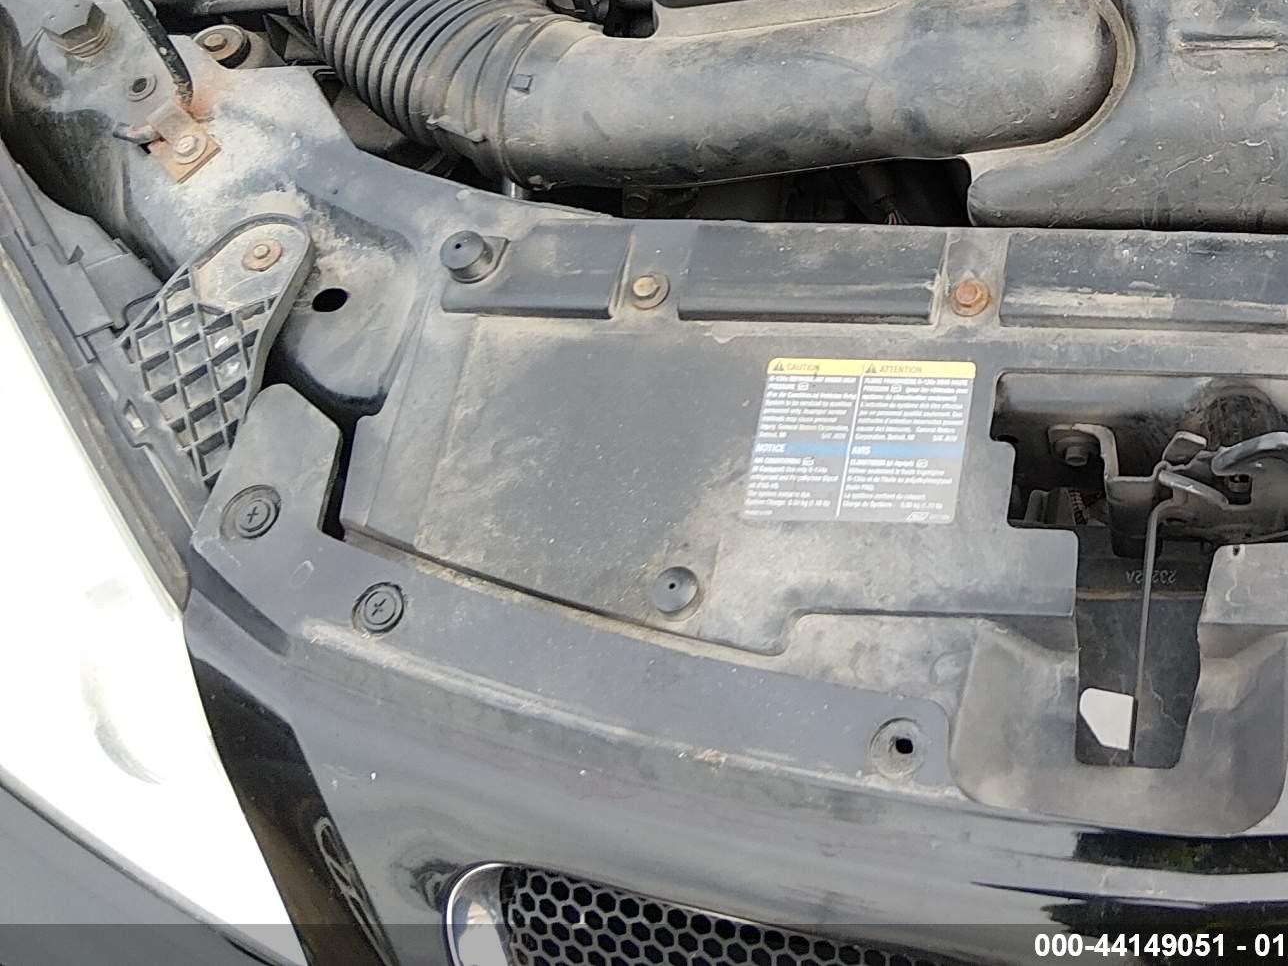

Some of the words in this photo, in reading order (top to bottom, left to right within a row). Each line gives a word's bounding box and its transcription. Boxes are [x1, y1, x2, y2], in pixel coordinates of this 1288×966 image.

[786, 363, 821, 372] CAUTION
[879, 365, 923, 374] ATTENTION
[755, 443, 786, 453] NOTICE
[851, 446, 871, 455] AVIS
[1125, 570, 1177, 585] 2322A
